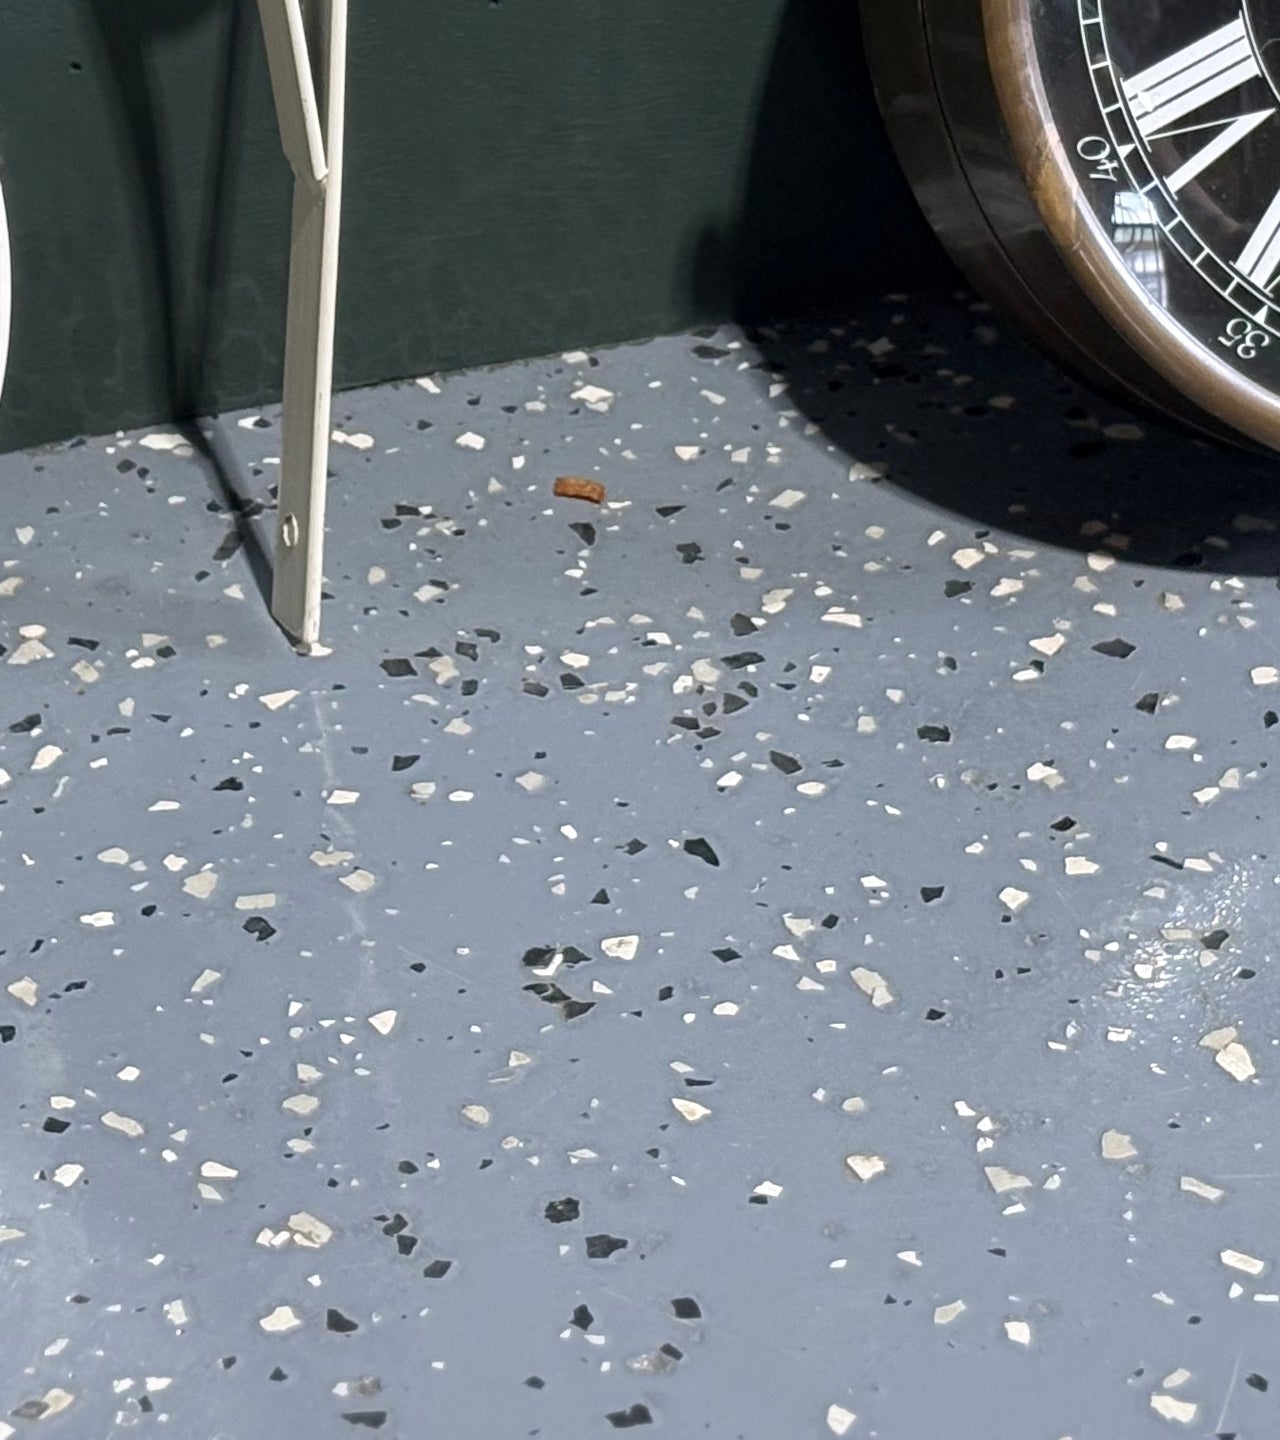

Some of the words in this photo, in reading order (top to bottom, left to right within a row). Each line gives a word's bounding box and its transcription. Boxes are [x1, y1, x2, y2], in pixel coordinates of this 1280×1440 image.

[1119, 9, 1278, 202] VIII
[1075, 134, 1121, 183] 40
[1216, 317, 1271, 360] 35
